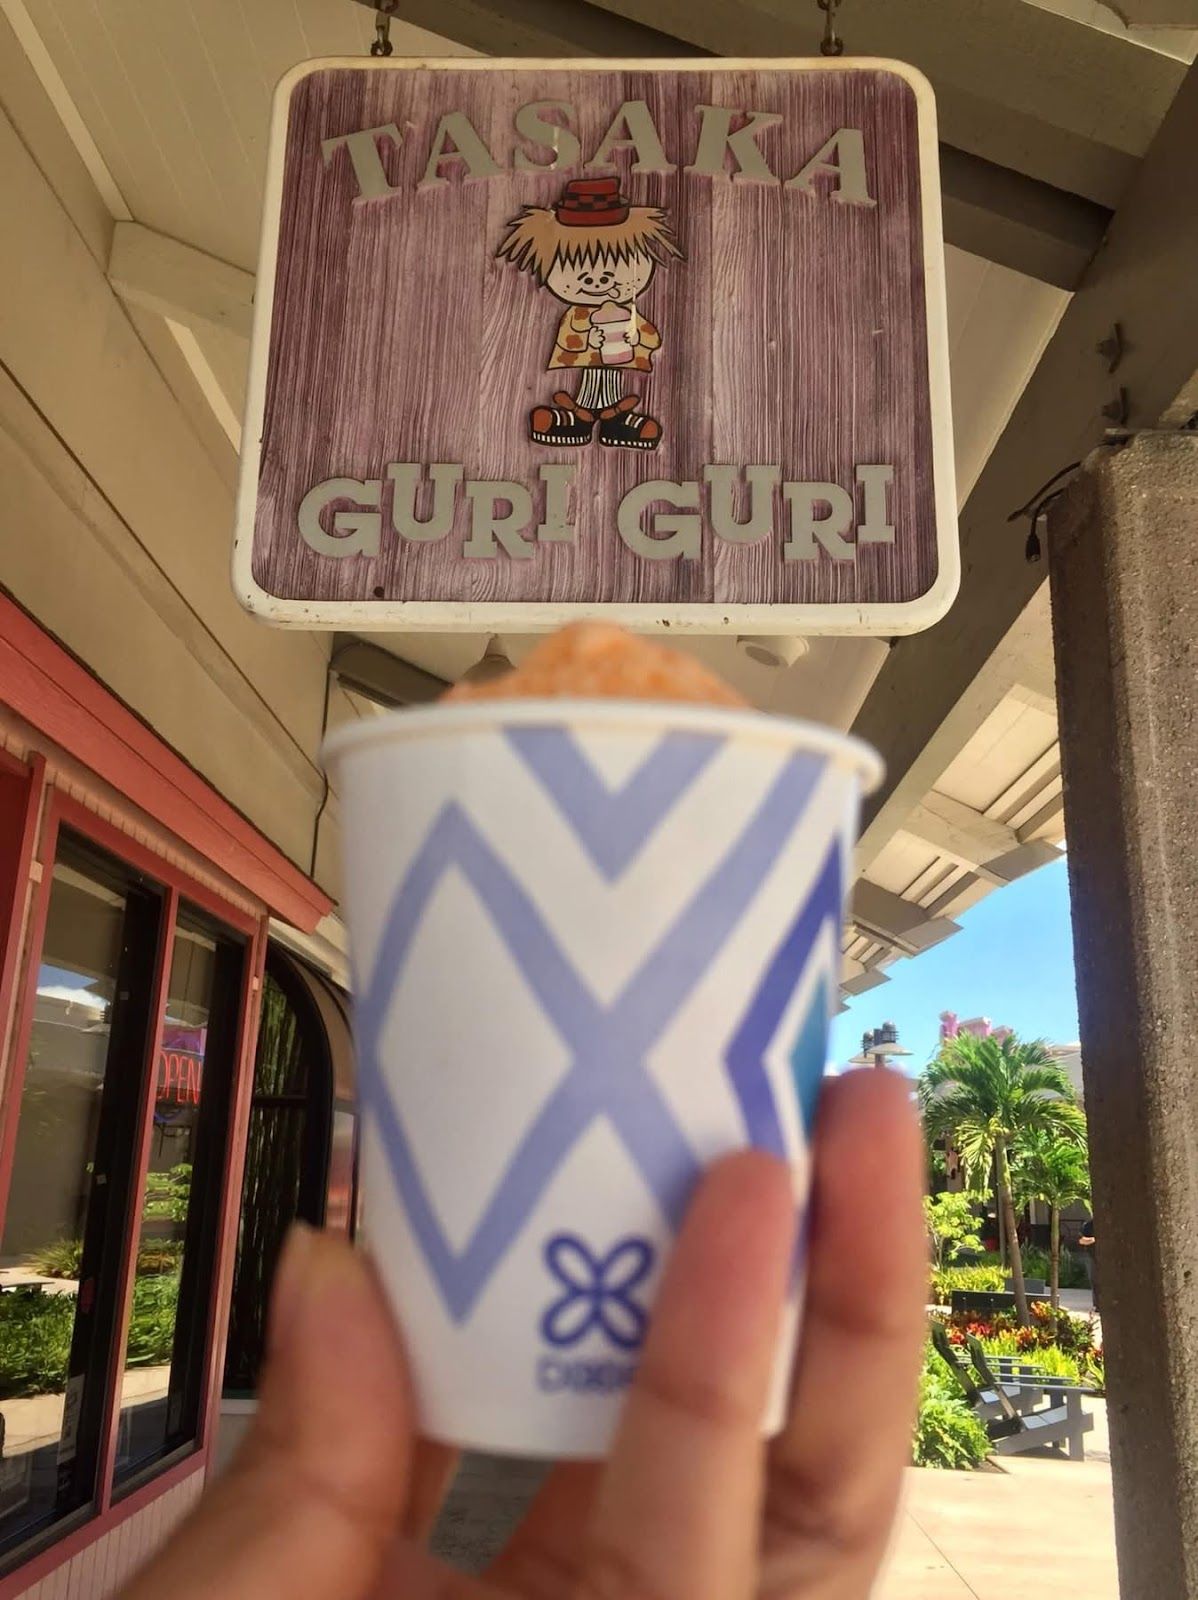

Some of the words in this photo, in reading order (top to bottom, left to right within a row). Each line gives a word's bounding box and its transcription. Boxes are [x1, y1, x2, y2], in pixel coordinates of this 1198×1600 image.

[322, 99, 877, 206] TASAKA
[299, 463, 576, 560] GURI
[616, 463, 896, 562] GURI
